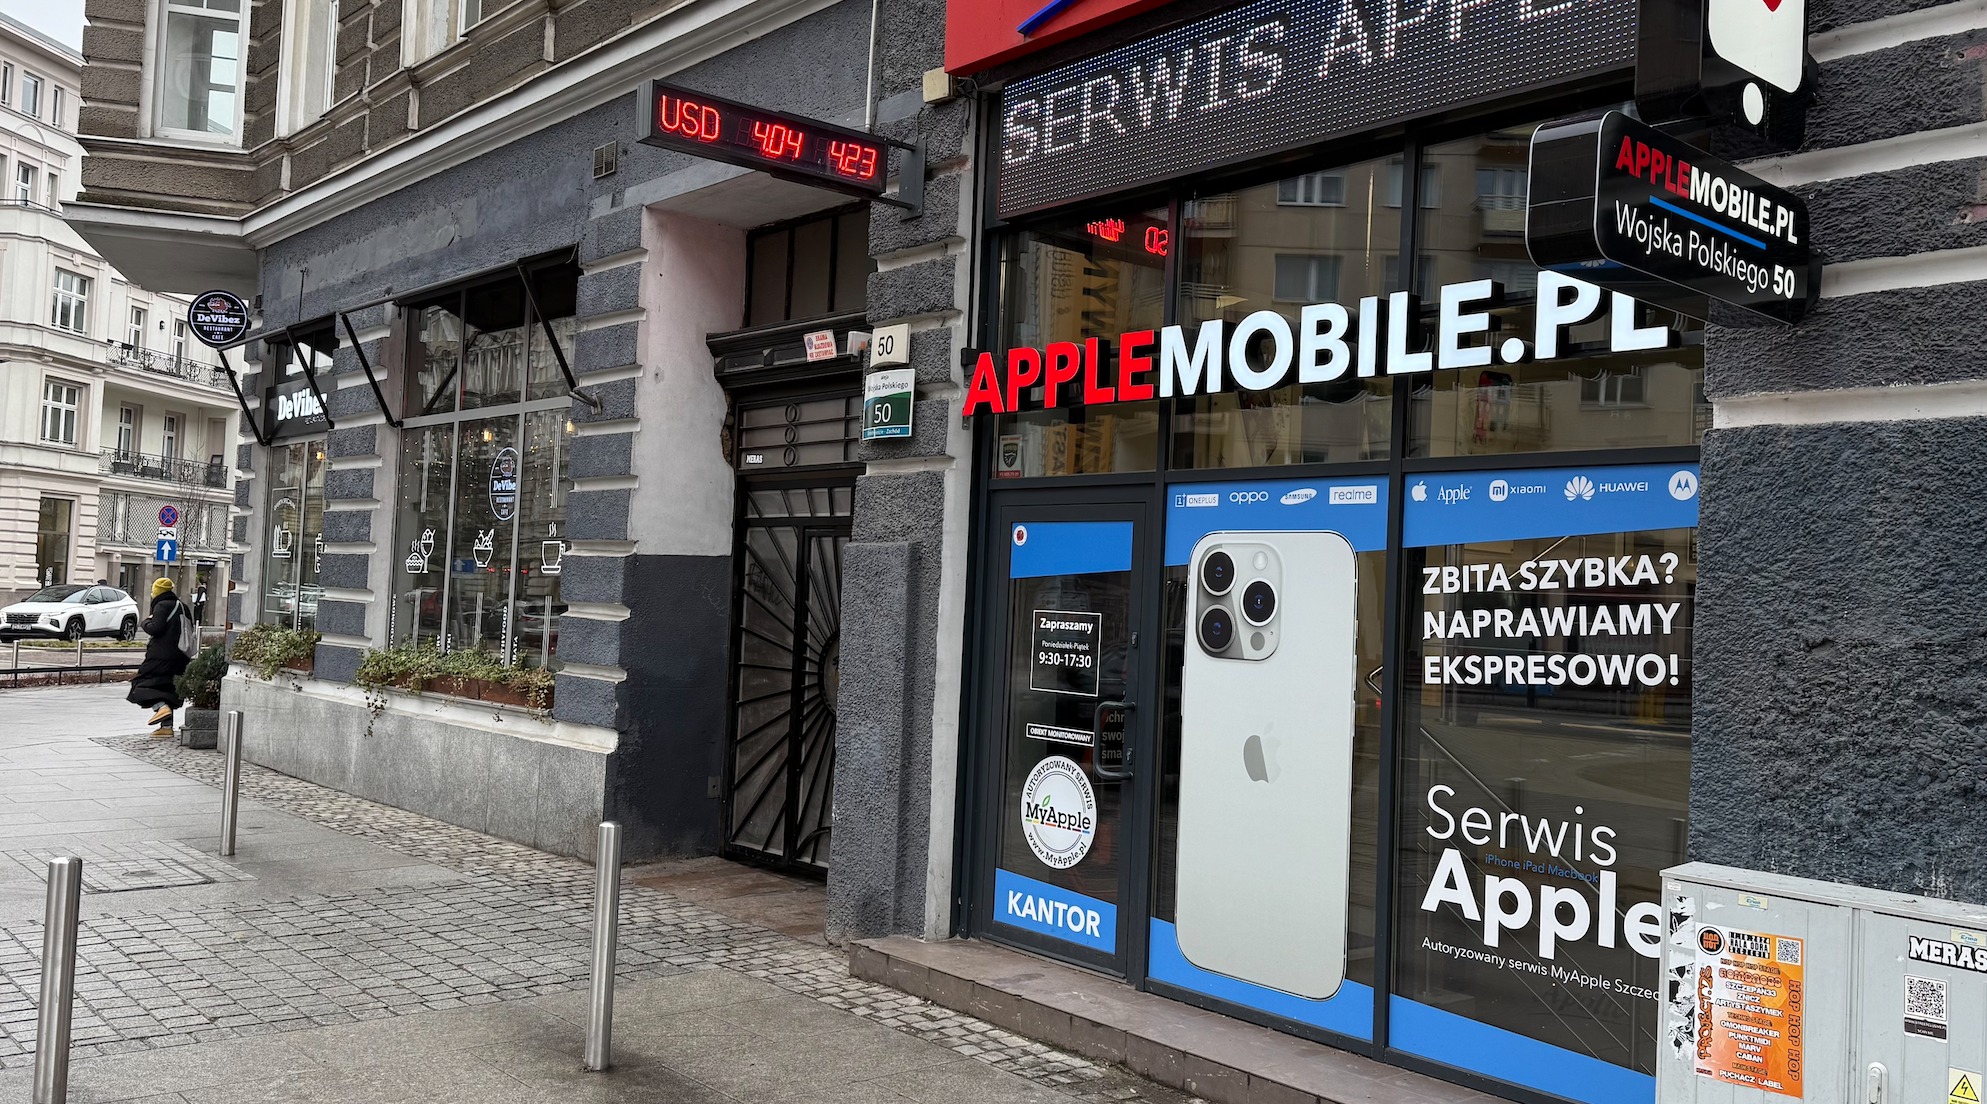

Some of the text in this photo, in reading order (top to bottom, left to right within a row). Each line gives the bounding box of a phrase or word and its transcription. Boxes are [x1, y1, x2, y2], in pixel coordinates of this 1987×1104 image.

[1002, 20, 1284, 164] SERWIS
[660, 94, 721, 141] USD
[1616, 135, 1798, 244] APPLEMOBILE.PL
[1615, 200, 1796, 299] Wojska Polskiego 50
[197, 314, 240, 323] DeVibez
[877, 335, 894, 357] 50
[874, 403, 892, 423] 50
[1229, 491, 1269, 504] oppo
[1284, 493, 1313, 501] SAMSUNG
[1333, 488, 1372, 501] realme
[1599, 481, 1648, 492] HUAWEI
[1188, 496, 1217, 505] ONEPLUS
[1423, 552, 1679, 595] ZBITA SZYBKA?
[1040, 618, 1093, 634] Zapraszamy
[1423, 602, 1680, 639] NAPRAWIAMY
[1039, 652, 1092, 668] 9:30-17:30
[1424, 653, 1679, 686] EKSPRESOWO!
[1048, 730, 1091, 742] MONITOROWANY
[1026, 760, 1094, 811] AUTORYZOWANY SERWIS
[1026, 802, 1091, 831] MyApple
[1425, 784, 1617, 867] Serwis
[1028, 832, 1087, 866] www.MyApple.pl
[1485, 854, 1599, 883] iPhone iPad Macbook
[1008, 890, 1100, 937] KANTOR
[1420, 848, 1662, 960] Apple
[1421, 937, 1505, 969] Autoryzowany
[1508, 958, 1547, 976] serwis
[1551, 965, 1611, 990] MyApple
[1909, 936, 1987, 972] MERAS
[1737, 992, 1760, 1002] ZNICZ
[1720, 1020, 1780, 1039] OMONBREAKER
[1728, 1031, 1771, 1046] PUNKTMIDI
[1787, 979, 1802, 1081] HOP HOP HOP
[1736, 1051, 1763, 1063] CABAN
[1738, 1042, 1761, 1052] MARV
[1719, 1069, 1756, 1083] PUCHACZ
[1758, 1078, 1784, 1090] LABEL
